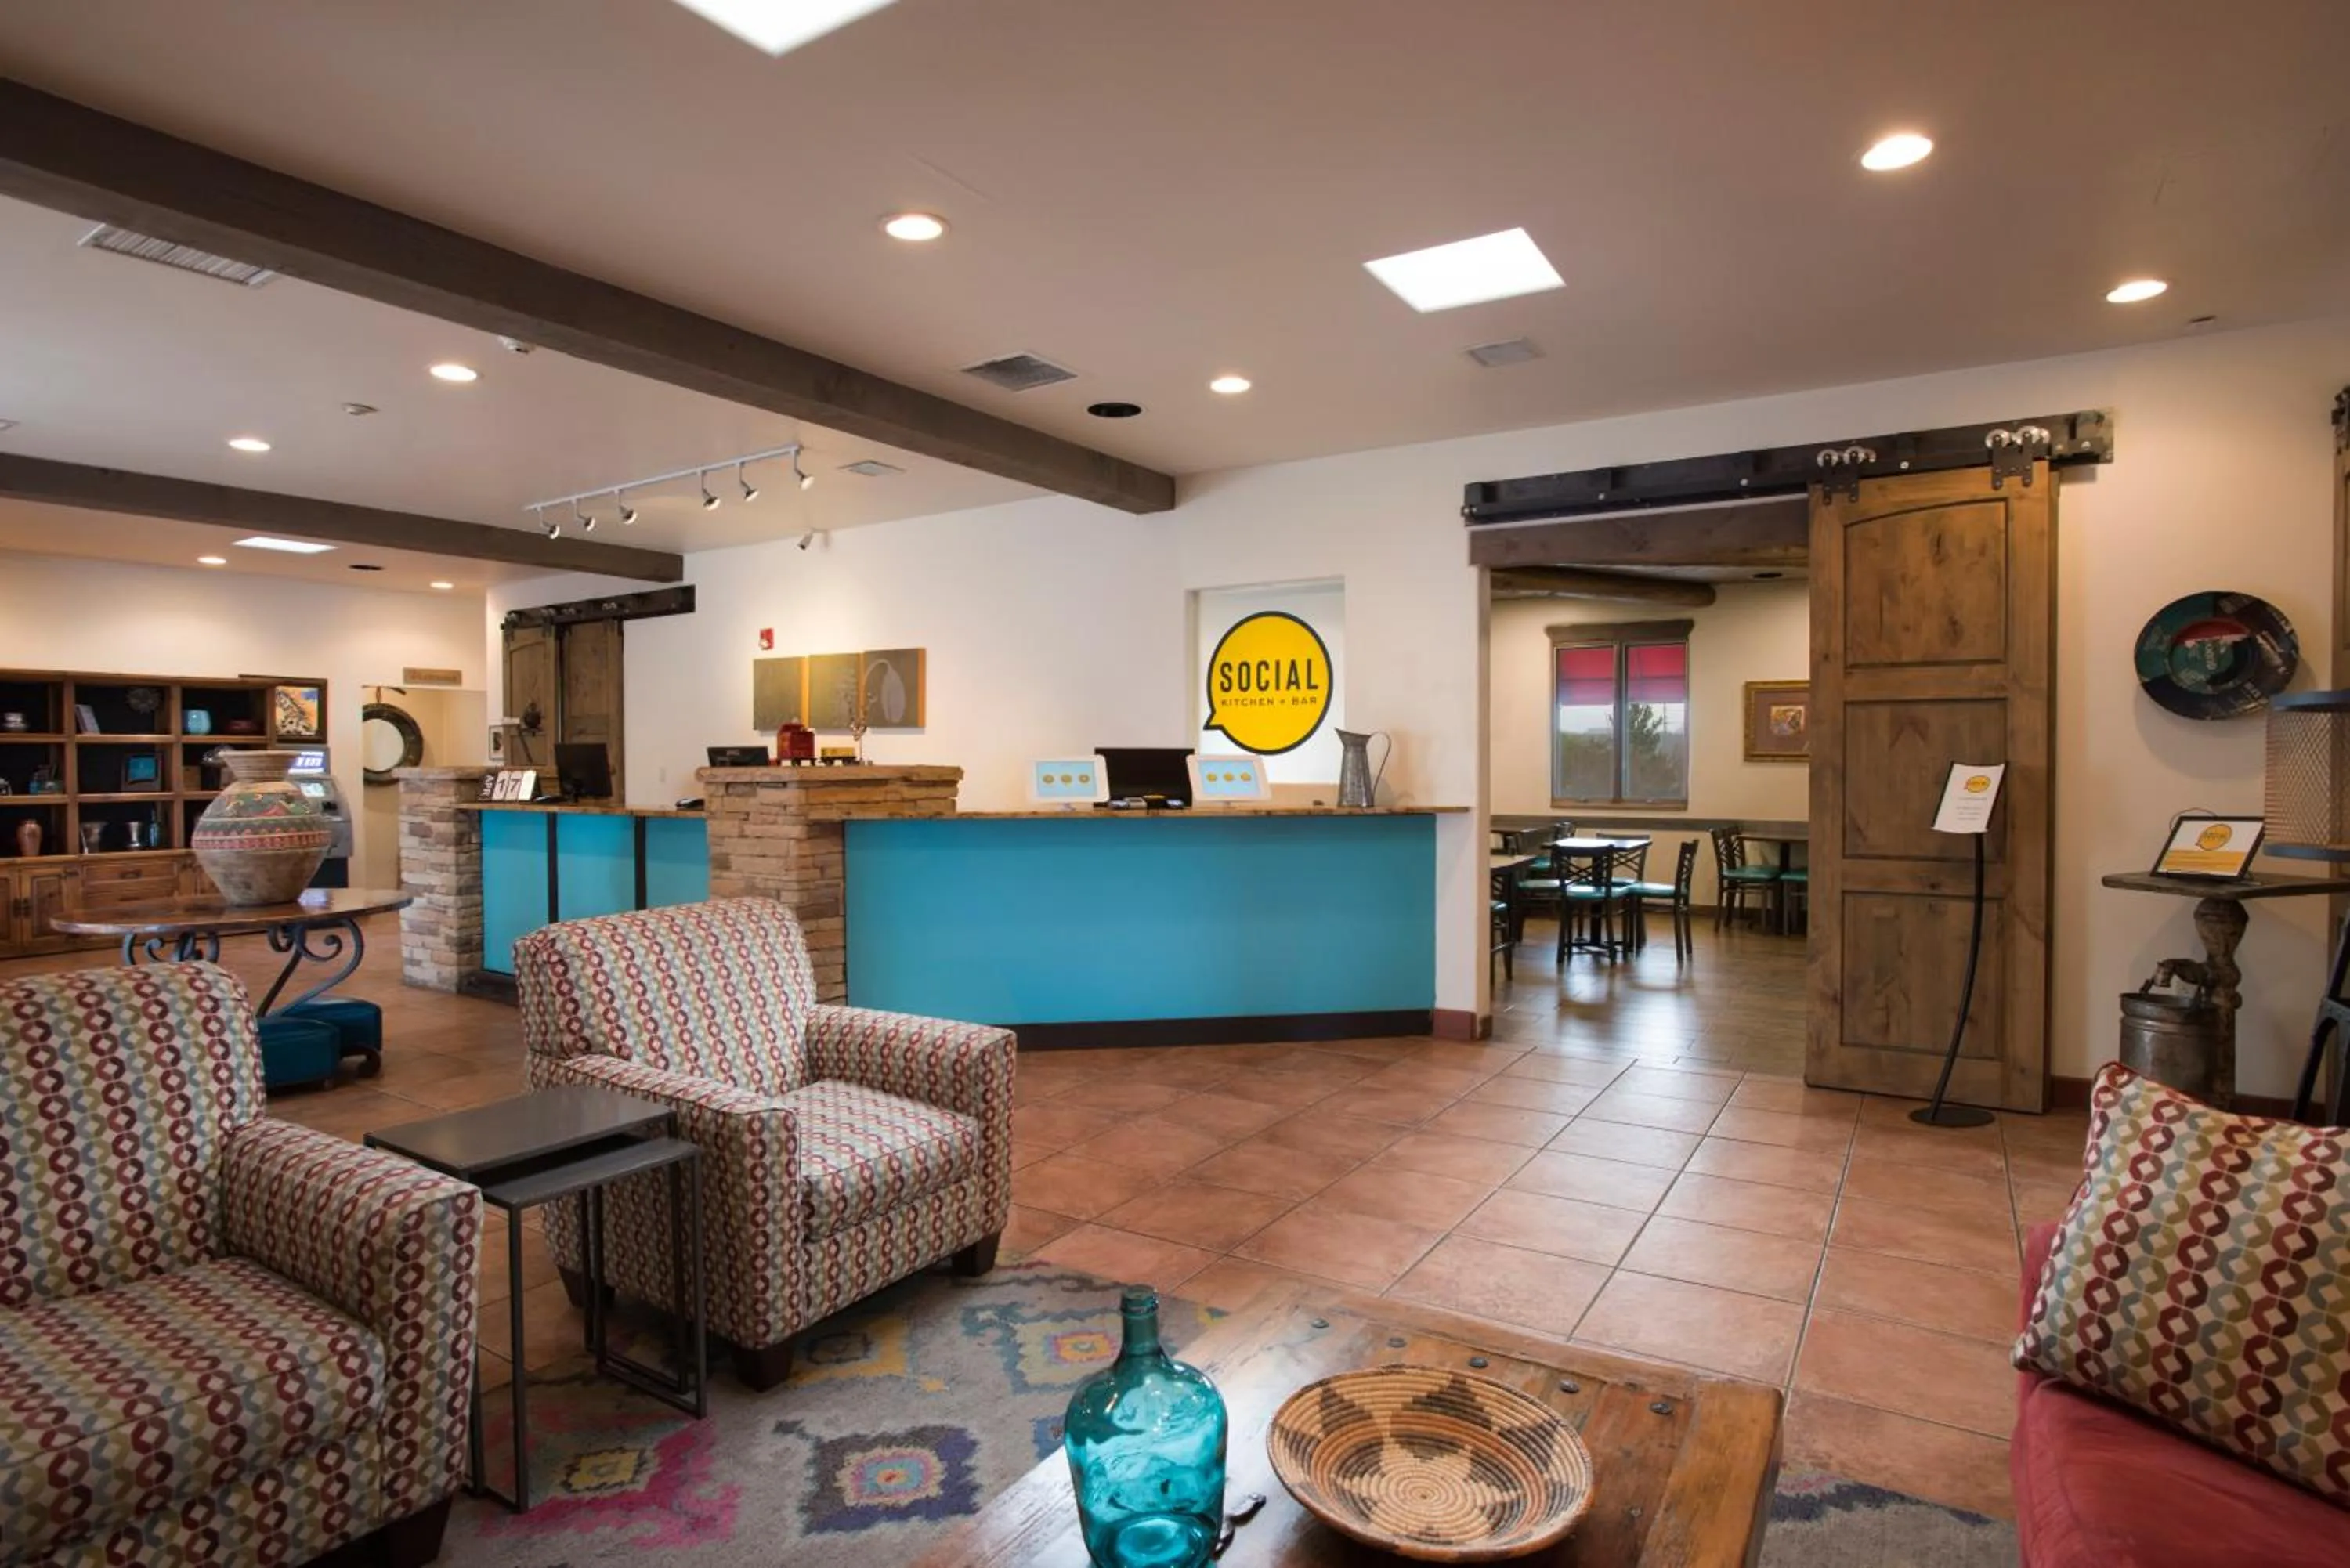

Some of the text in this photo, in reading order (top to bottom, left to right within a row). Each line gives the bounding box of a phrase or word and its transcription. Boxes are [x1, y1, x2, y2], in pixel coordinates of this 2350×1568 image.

[1220, 659, 1318, 692] SOCIAL
[1221, 697, 1274, 707] KITCHEN
[1292, 696, 1318, 706] BAR
[497, 778, 522, 793] 17
